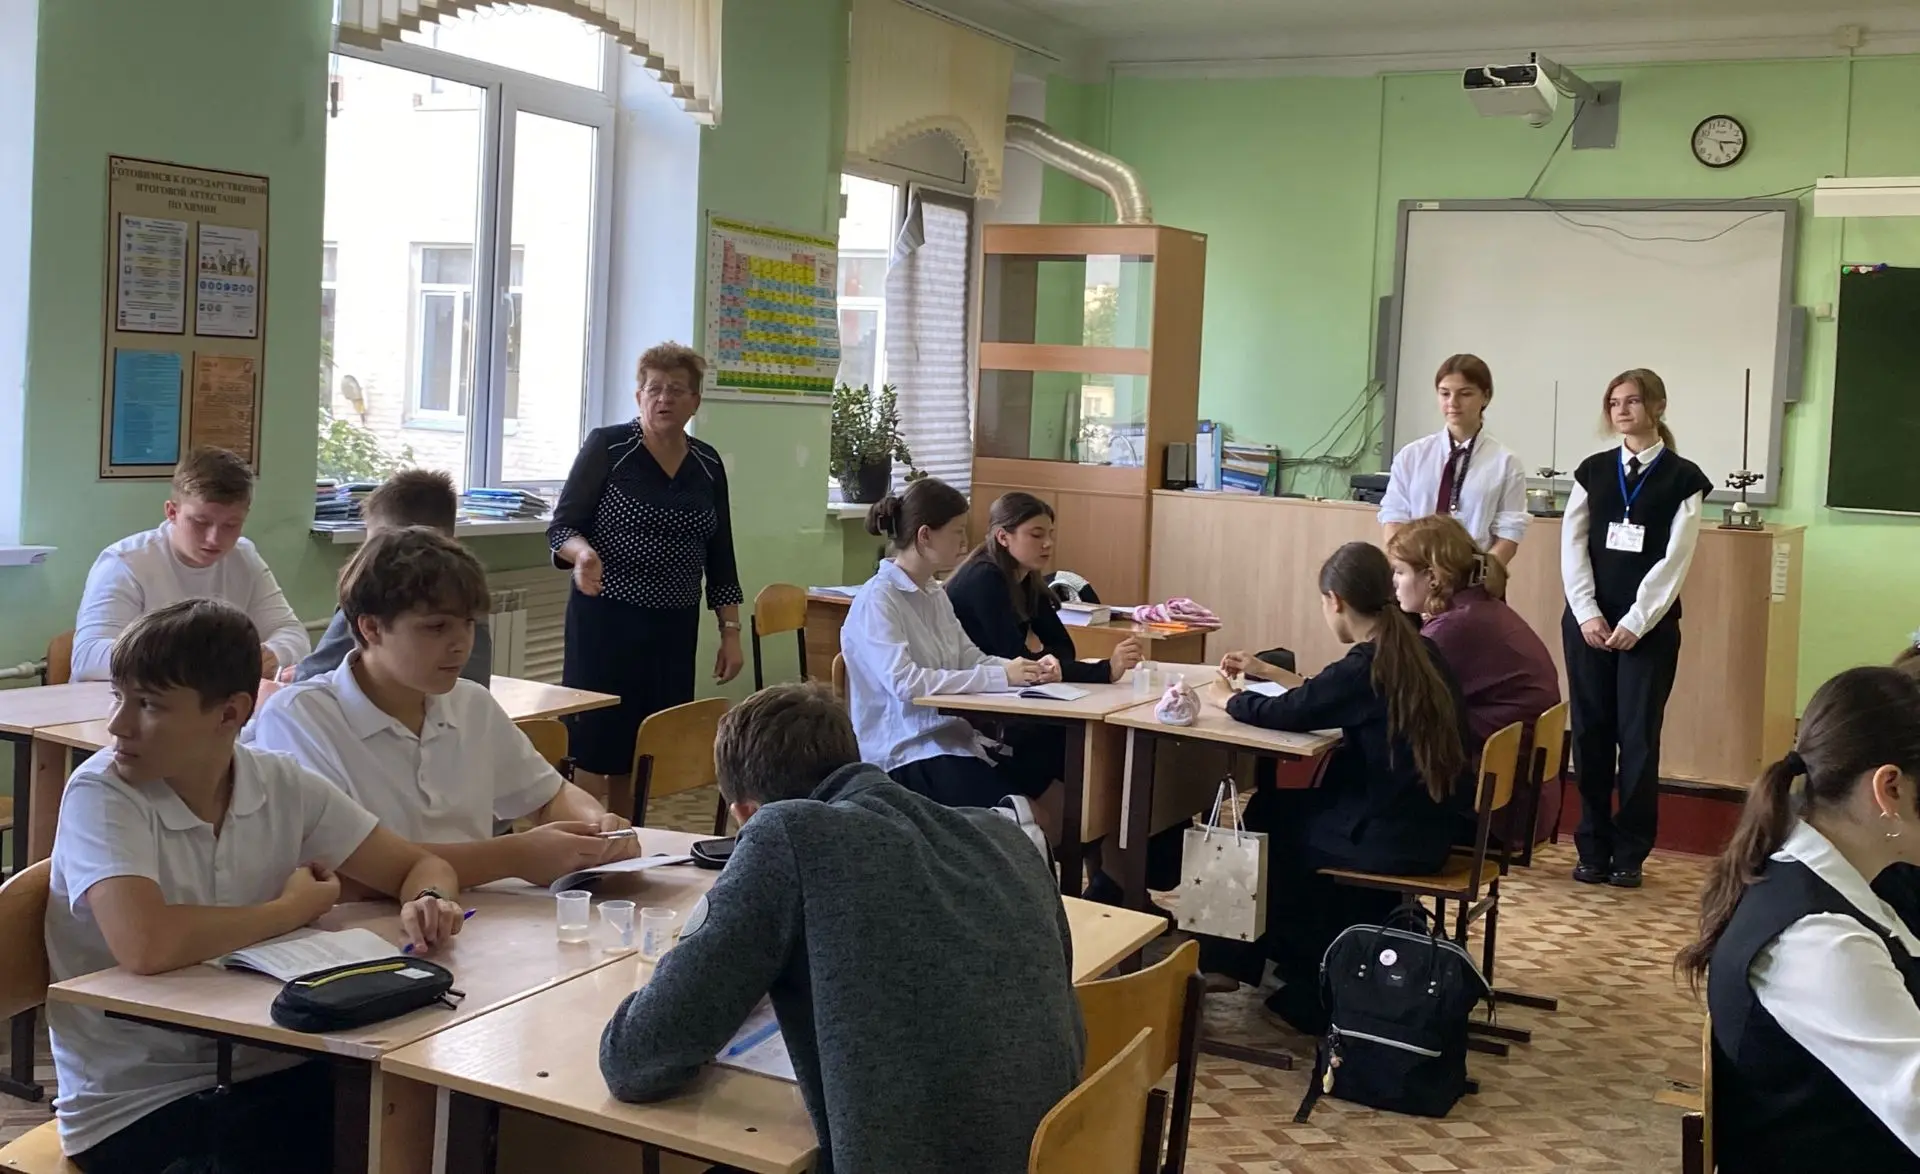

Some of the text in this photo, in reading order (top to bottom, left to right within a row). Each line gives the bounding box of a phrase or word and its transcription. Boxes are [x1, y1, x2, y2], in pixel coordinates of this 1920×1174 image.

[112, 166, 267, 195] ГОТОВИМСЯ К ГОСУДАРСТВЕННОЙ
[136, 183, 187, 197] ИТОГОВОЙ
[168, 200, 217, 214] ПО ХИМИИ
